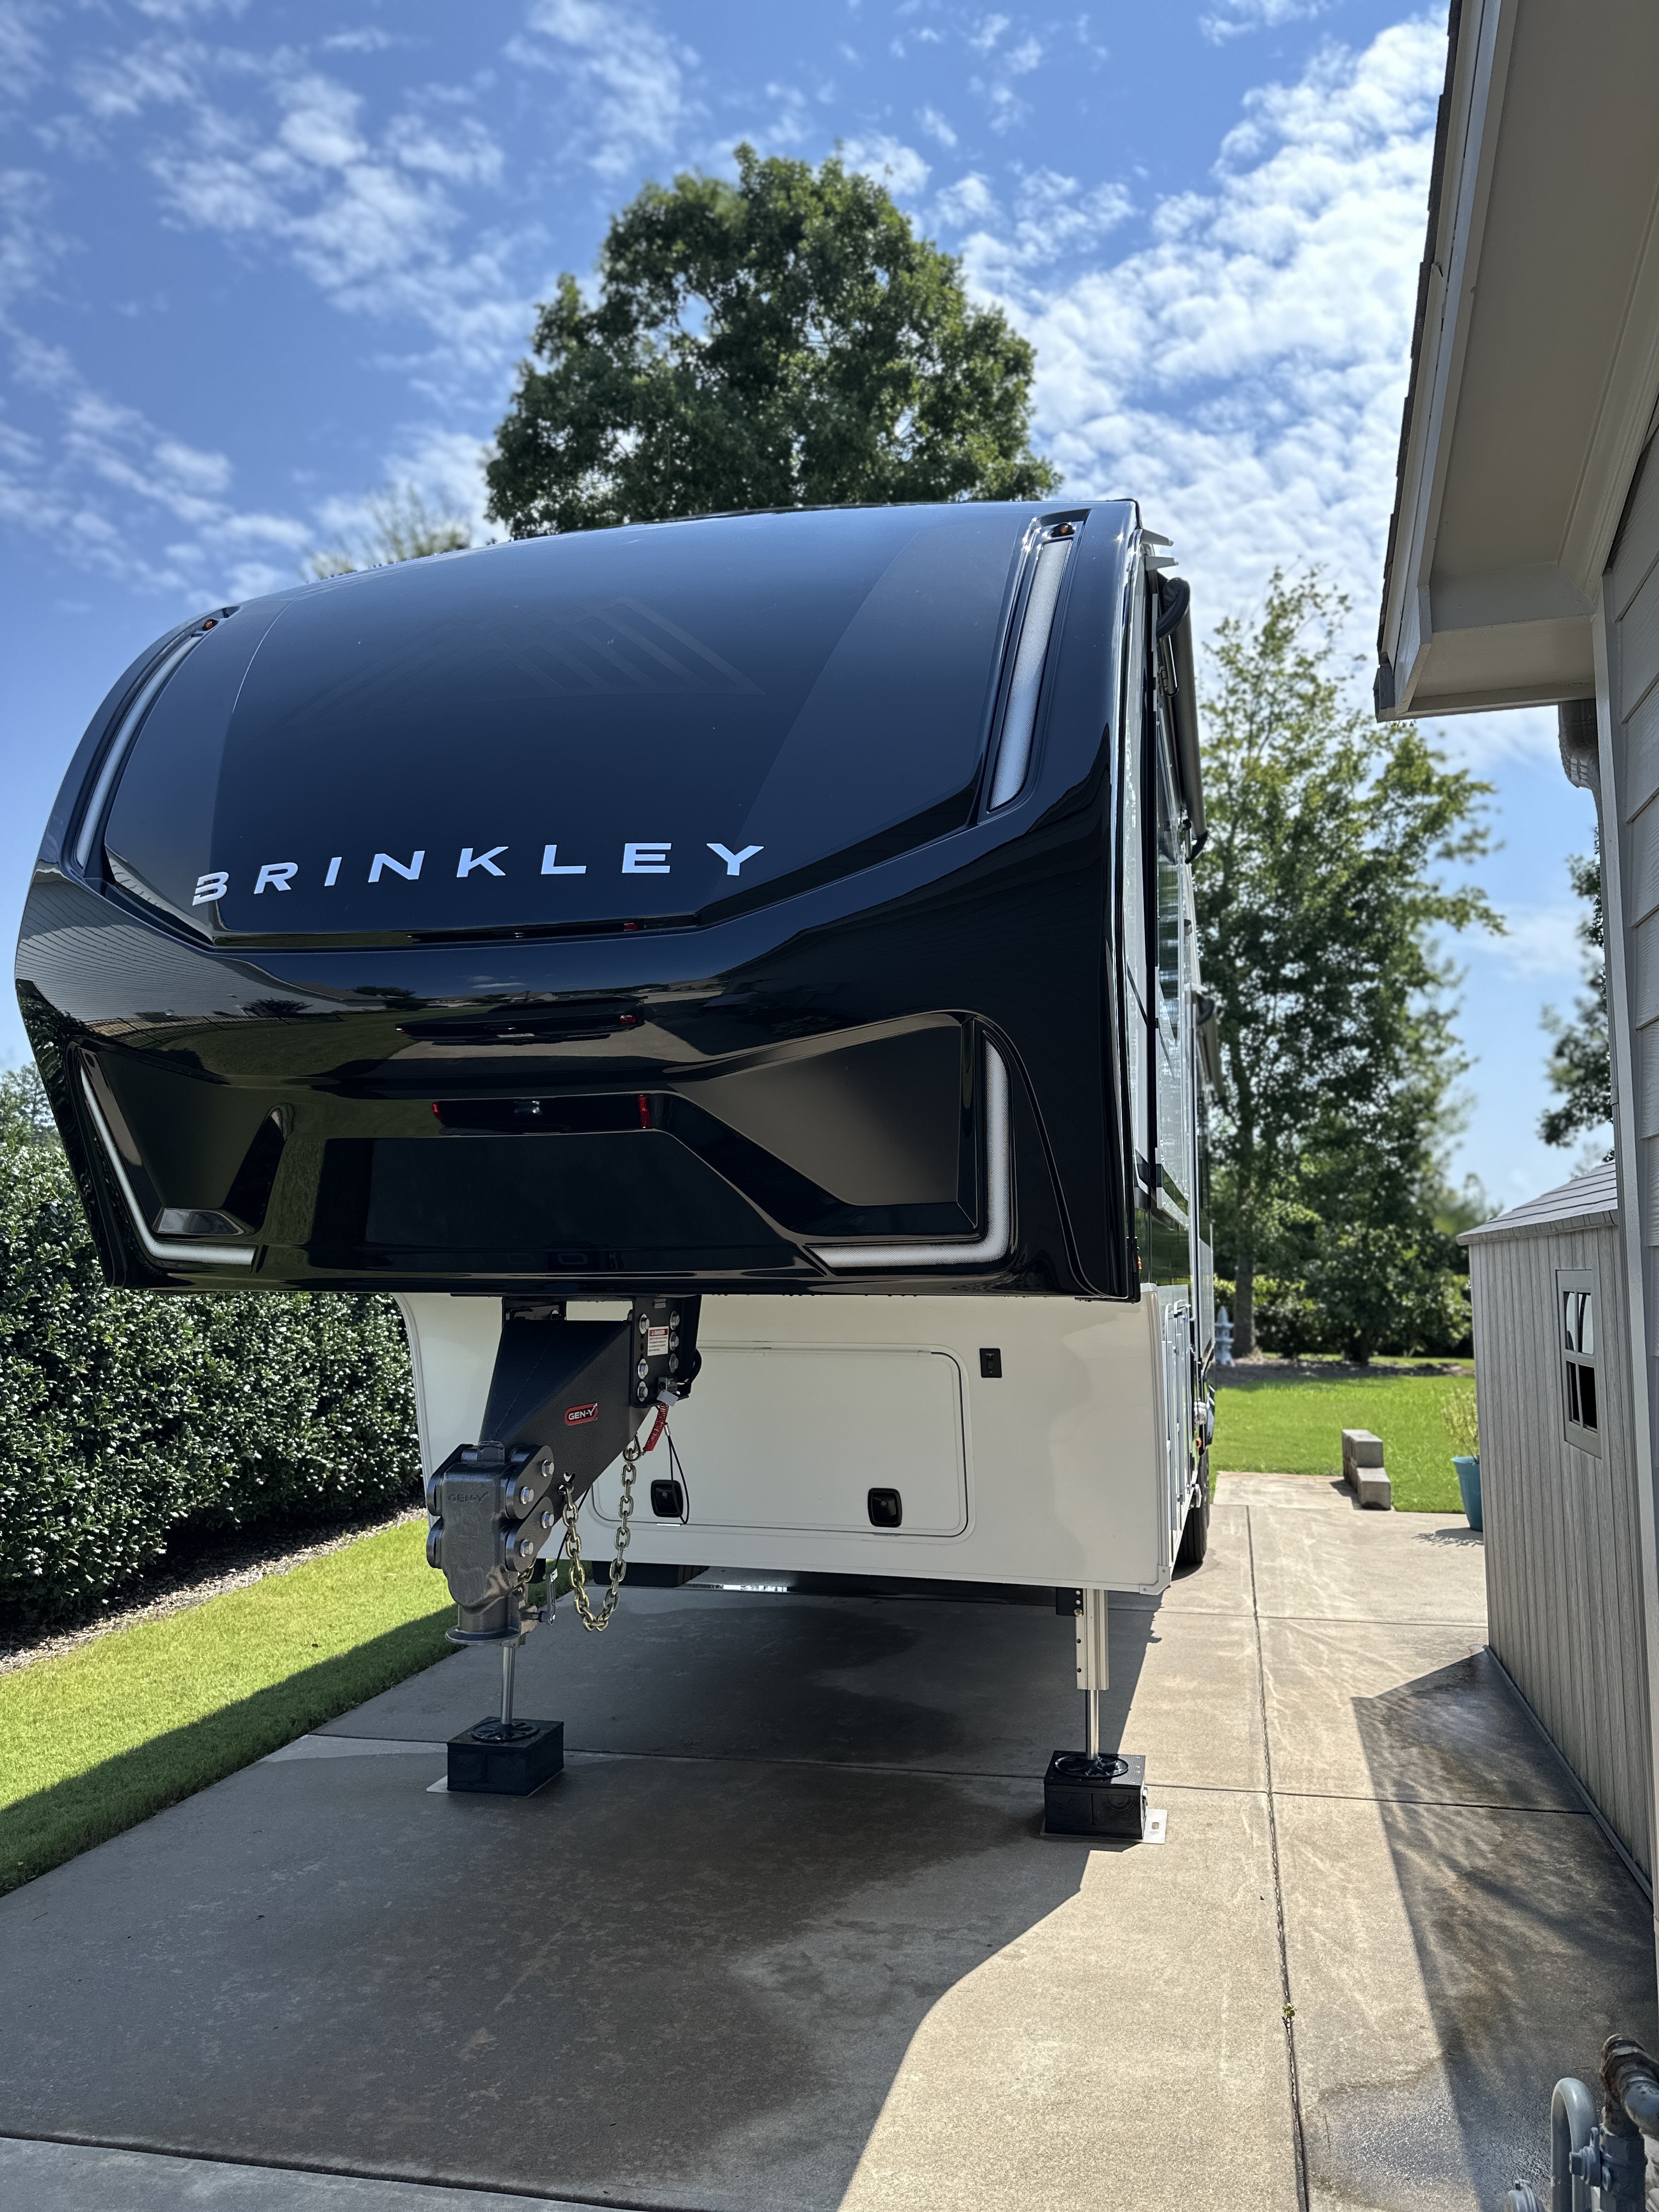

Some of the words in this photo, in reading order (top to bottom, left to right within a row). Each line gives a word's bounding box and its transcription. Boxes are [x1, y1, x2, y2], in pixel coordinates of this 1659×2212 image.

[192, 843, 764, 906] BRINKLEY
[568, 1402, 598, 1420] GEN-Y
[448, 1491, 489, 1502] GEN-Y
